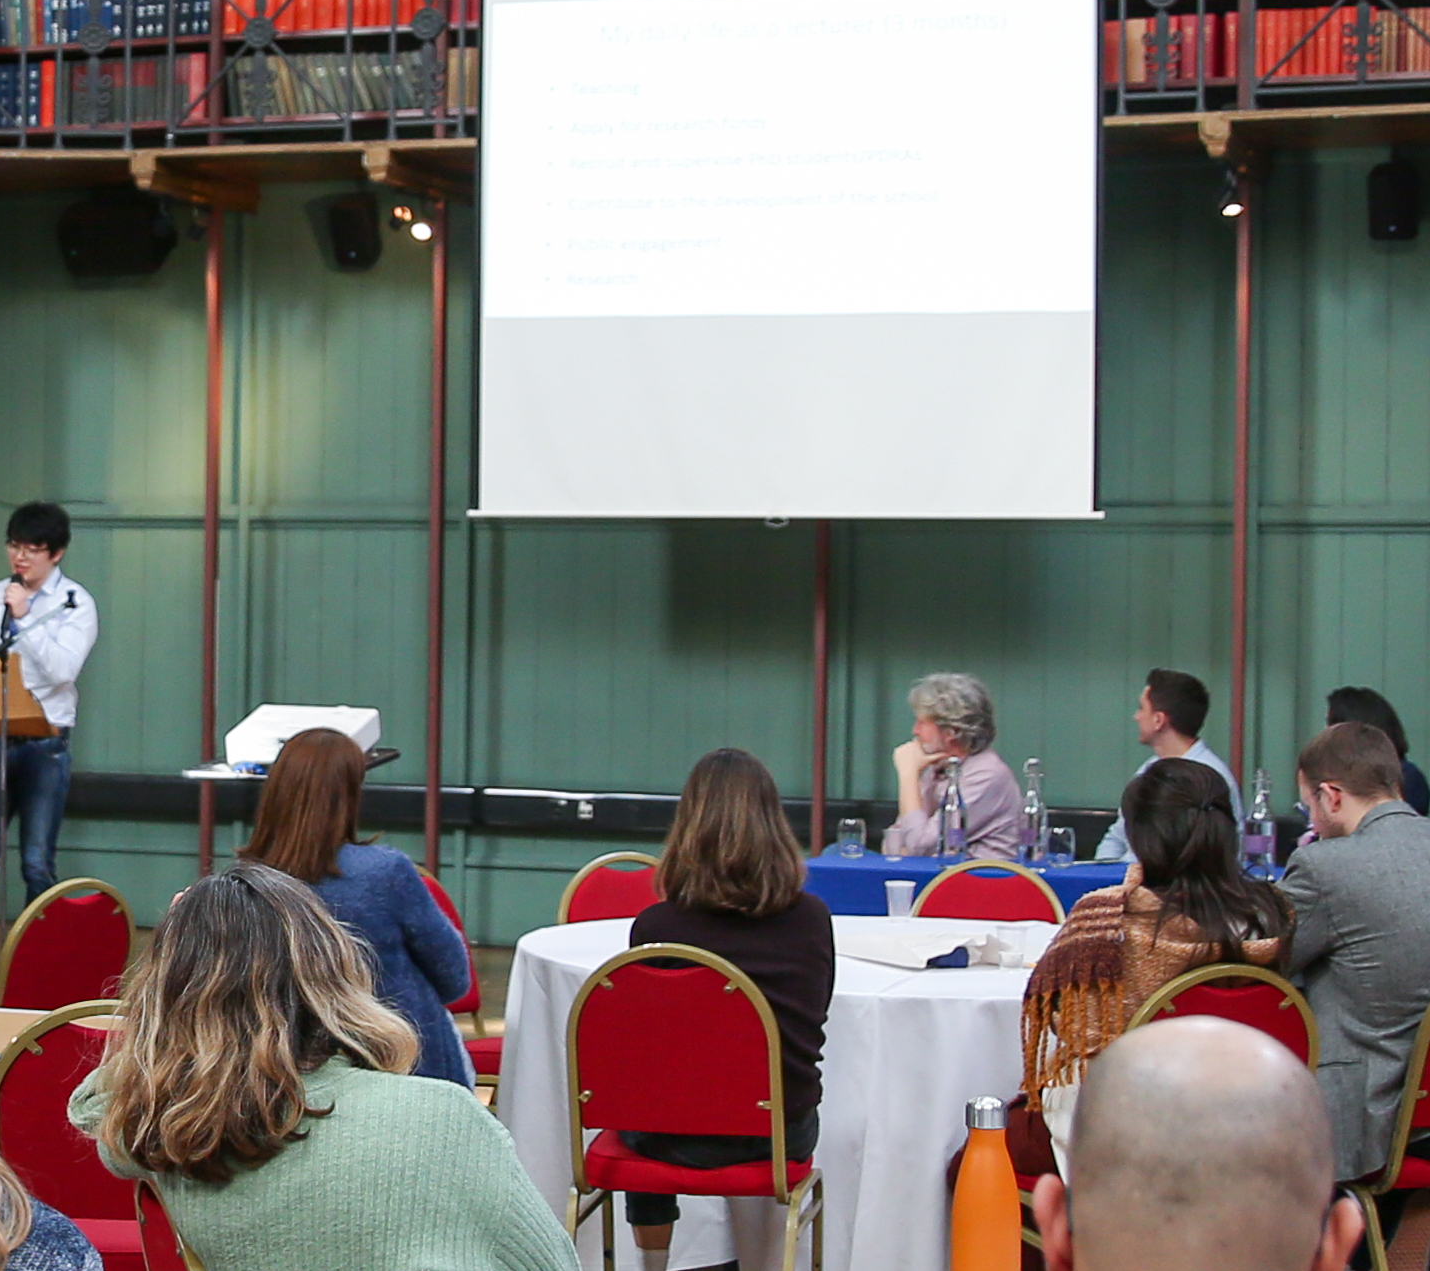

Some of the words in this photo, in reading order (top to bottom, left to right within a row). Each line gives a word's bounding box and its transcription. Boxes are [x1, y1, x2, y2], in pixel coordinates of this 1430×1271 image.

[598, 24, 634, 46] My
[640, 22, 692, 44] daily
[697, 20, 731, 40] life
[737, 22, 762, 38] as
[767, 22, 780, 38] a
[786, 14, 875, 37] lecturer
[882, 12, 906, 37] (3
[912, 11, 1008, 34] months)
[572, 80, 641, 96] Teaching
[570, 119, 616, 136] Apply
[619, 118, 642, 133] for
[647, 116, 716, 132] research
[721, 115, 768, 130] funds
[568, 155, 626, 171] Recruit
[630, 154, 661, 169] and
[666, 153, 744, 170] supervise
[748, 152, 782, 167] PhD
[786, 148, 923, 166] students/PDRAs
[568, 194, 654, 211] Contribute
[660, 196, 676, 208] to
[681, 193, 708, 208] the
[713, 191, 824, 210] development
[827, 191, 846, 206] of
[850, 190, 878, 205] the
[882, 188, 939, 204] school
[566, 236, 615, 252] Public
[620, 235, 722, 254] engagement
[566, 272, 640, 286] Research
